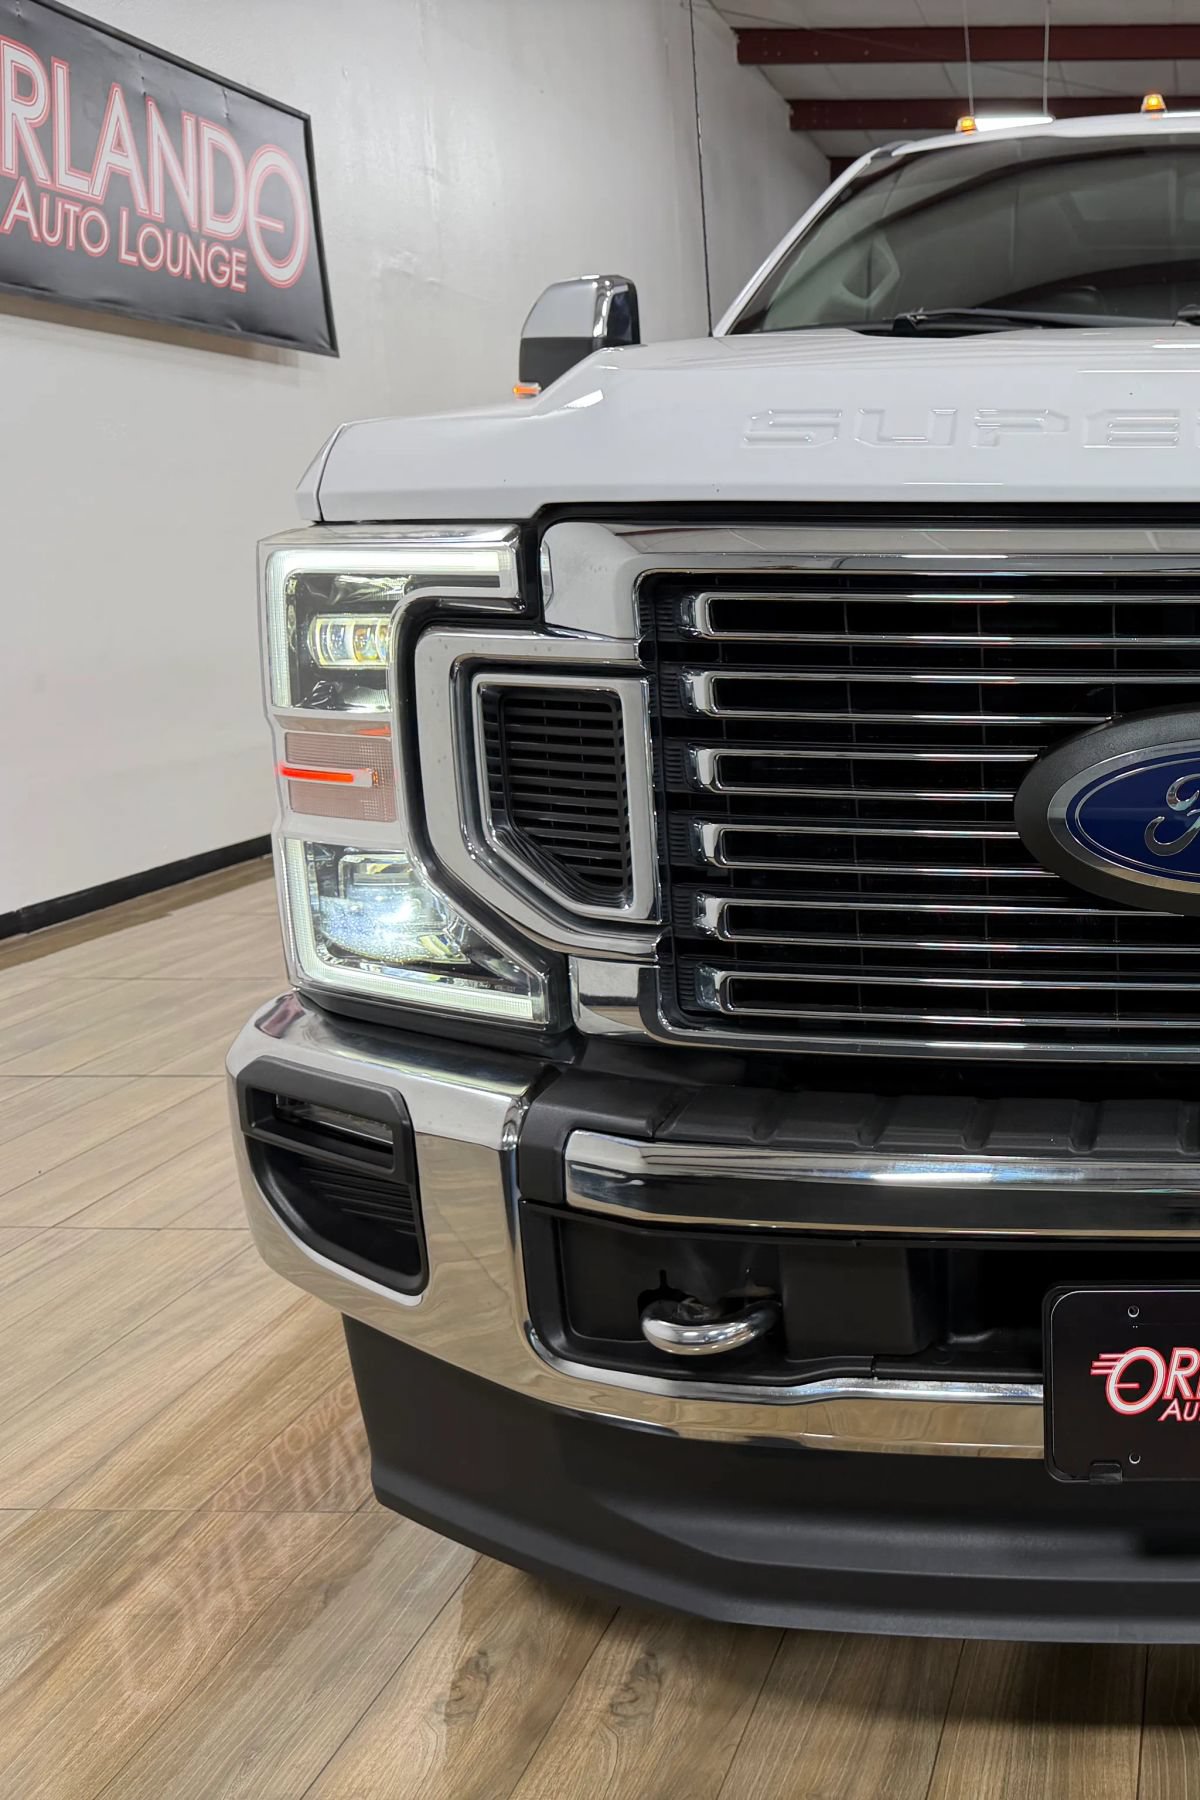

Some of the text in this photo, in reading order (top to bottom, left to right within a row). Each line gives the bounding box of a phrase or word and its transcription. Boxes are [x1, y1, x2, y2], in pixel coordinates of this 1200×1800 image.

[0, 34, 311, 289] RLANDO
[1, 176, 249, 294] AUTO LOUNGE
